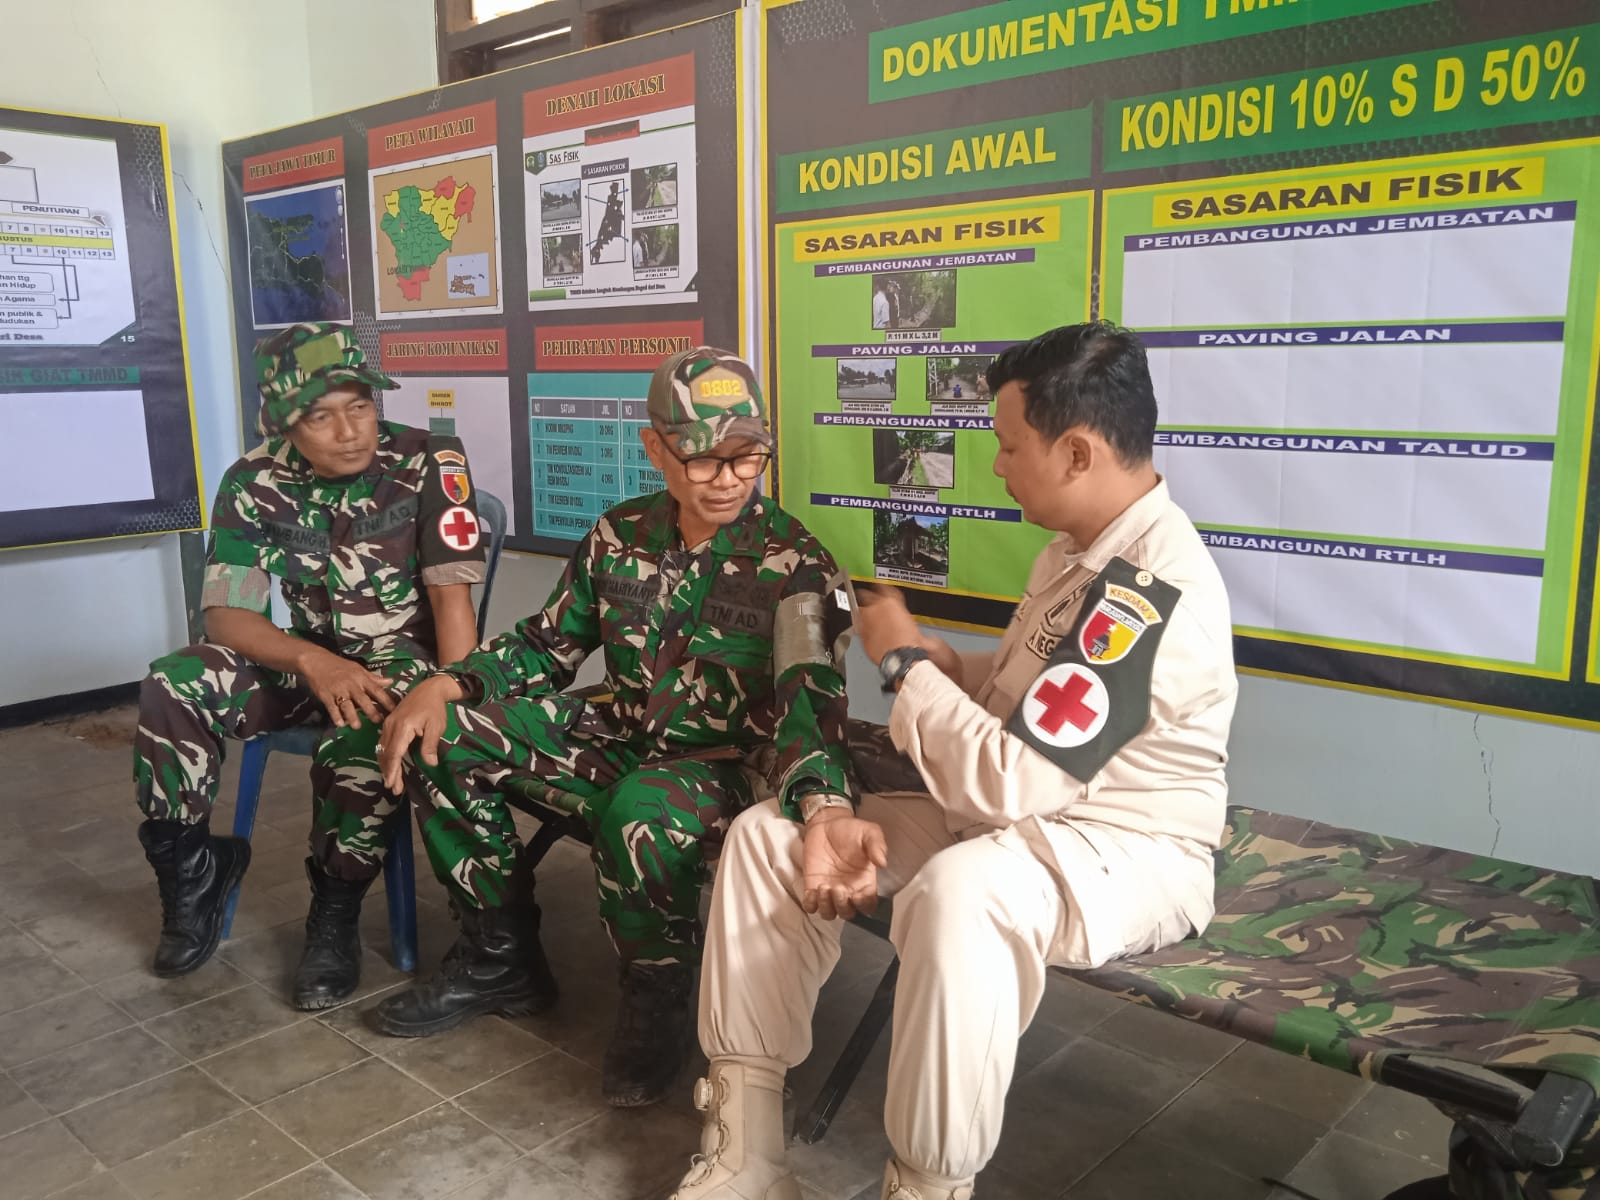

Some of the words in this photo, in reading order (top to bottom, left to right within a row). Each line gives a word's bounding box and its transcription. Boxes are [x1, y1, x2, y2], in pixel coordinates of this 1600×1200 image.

[883, 0, 1179, 83] DOKUMENTASI
[546, 89, 600, 117] DENAH
[604, 74, 666, 105] LOKASI
[1121, 84, 1275, 153] KONDISI
[1290, 69, 1374, 130] 10%
[1389, 63, 1419, 117] S
[1434, 57, 1465, 113] D
[1480, 36, 1587, 107] 50%
[385, 131, 416, 152] PETA
[417, 117, 475, 144] WILAYAH
[274, 156, 300, 174] JAWA
[302, 149, 337, 169] TIMUR
[549, 153, 563, 165] SAS
[563, 150, 580, 162] FISIK
[799, 143, 934, 194] KONDISI
[945, 127, 1057, 175] AWAL
[1170, 181, 1370, 220] SASARAN
[1388, 166, 1524, 202] FISIK
[22, 205, 80, 215] PENUTUPAN
[804, 226, 943, 254] SASARAN
[954, 216, 1045, 241] FISIK
[1138, 221, 1357, 249] PEMBANGUNAN
[1367, 206, 1554, 232] JEMBATAN
[828, 258, 932, 274] PEMBANGUNAN
[935, 251, 1017, 268] JEMBATAN
[9, 282, 36, 290] Hidup
[4, 295, 36, 303] Agama
[120, 335, 136, 343] 15
[542, 338, 616, 357] PELIBATAN
[1198, 333, 1319, 345] PAVING
[1329, 328, 1452, 343] JALAN
[386, 342, 425, 358] JARING
[426, 340, 500, 357] KOMUNIKASI
[851, 346, 914, 356] PAVING
[918, 344, 977, 355] JALAN
[823, 415, 951, 427] PEMBANGUNAN
[1151, 434, 1386, 452] EMBANGUNAN
[1398, 443, 1528, 457] TALUD
[830, 496, 947, 515] PEMBANGUNAN
[952, 506, 996, 519] RTLH
[1201, 533, 1366, 556] EMBANGUNAN
[1375, 548, 1446, 566] RTLH
[735, 611, 759, 629] AD
